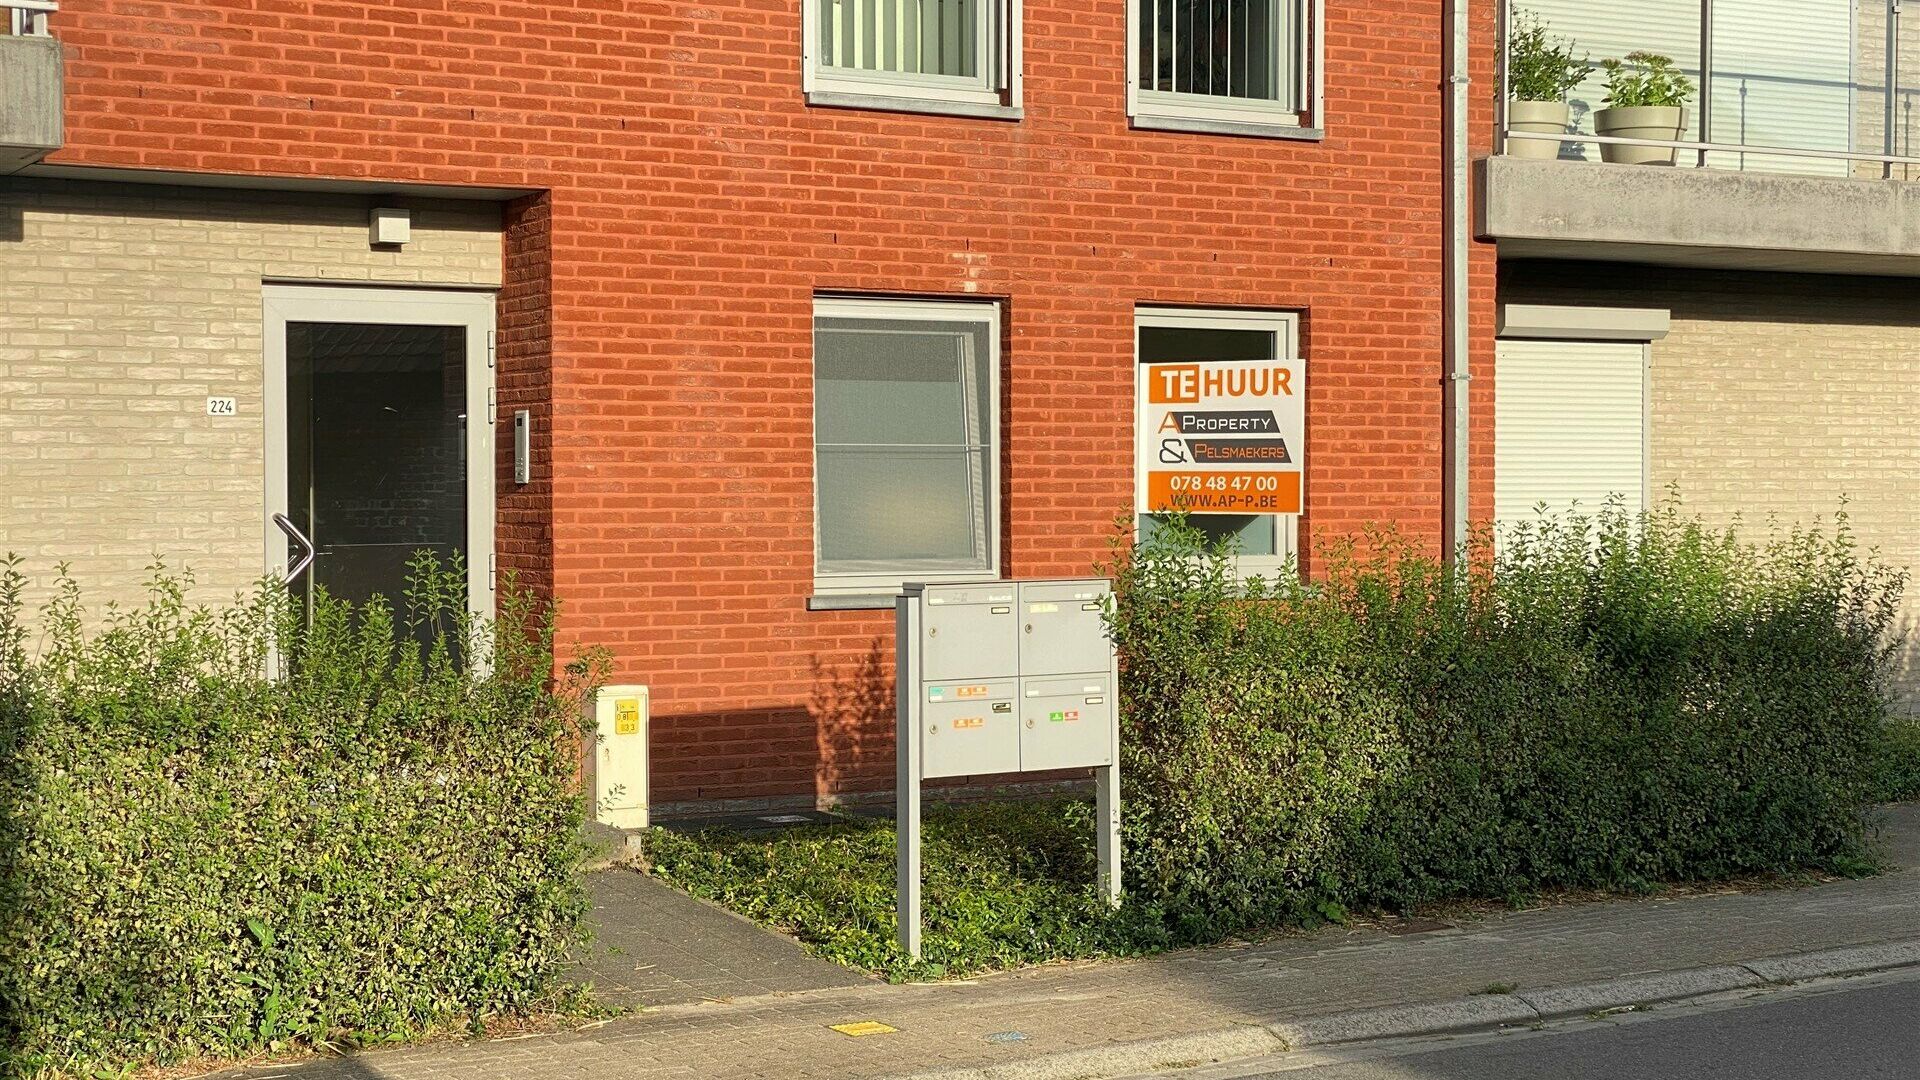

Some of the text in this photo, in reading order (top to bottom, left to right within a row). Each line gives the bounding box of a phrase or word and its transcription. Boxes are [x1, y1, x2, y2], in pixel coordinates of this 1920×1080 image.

[1160, 368, 1293, 399] TE HUUR
[210, 400, 233, 413] 224
[1159, 438, 1285, 464] & PELSMAEKERS
[1170, 476, 1278, 491] 078 48 47 00
[1170, 494, 1278, 508] WWW.AP-P.BE
